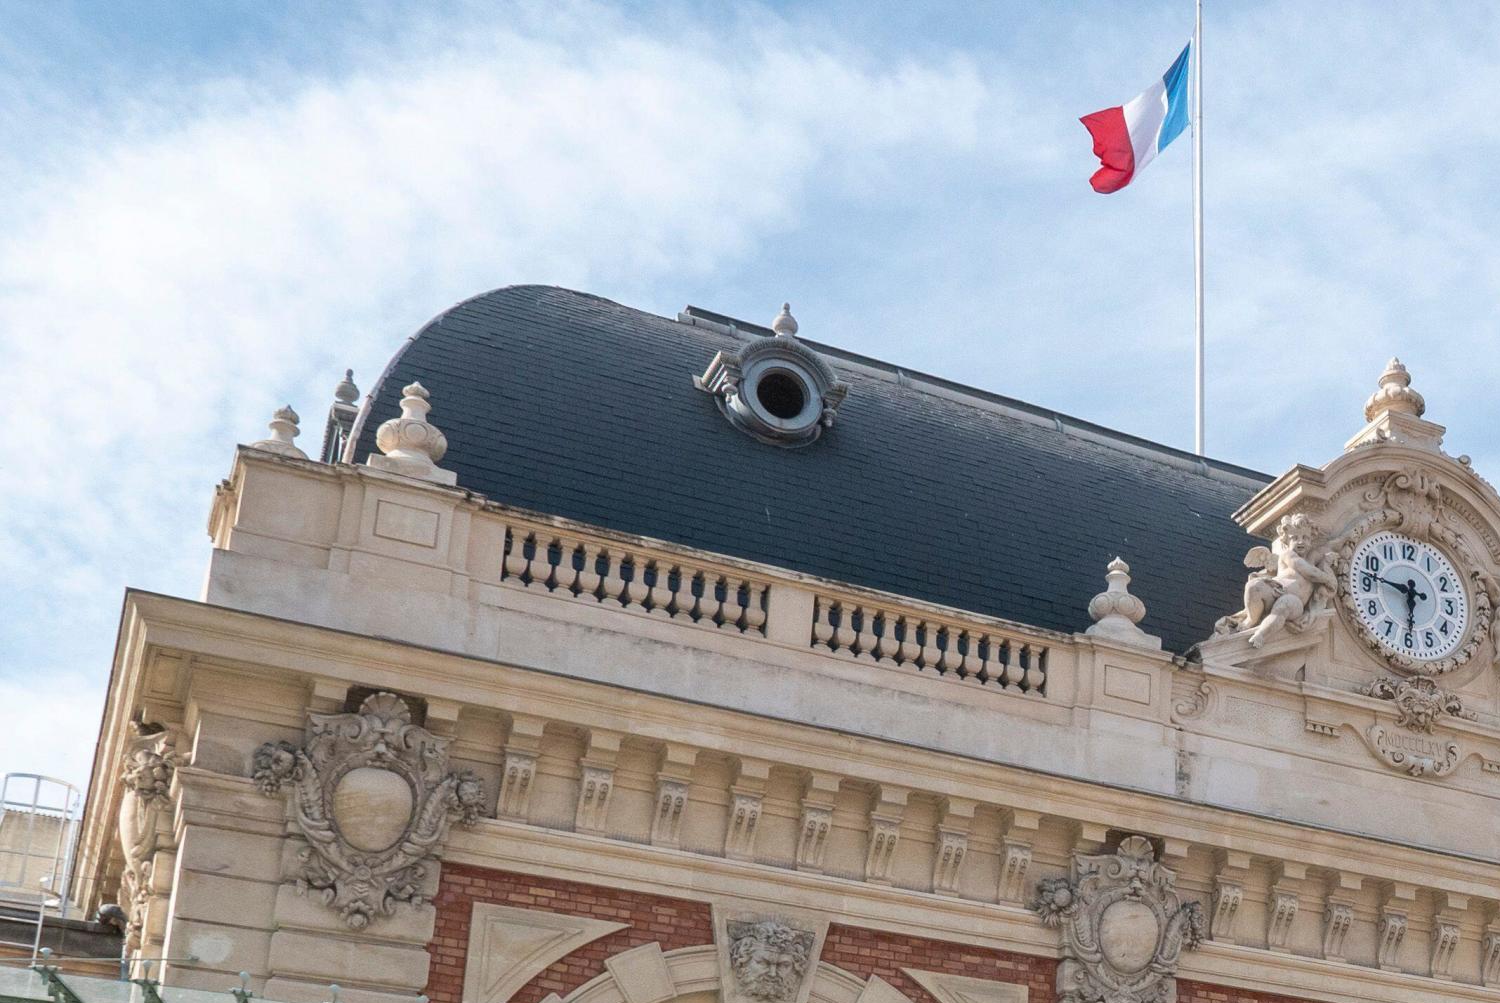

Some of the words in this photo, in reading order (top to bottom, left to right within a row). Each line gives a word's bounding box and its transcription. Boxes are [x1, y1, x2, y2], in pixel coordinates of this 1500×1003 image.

[1383, 545, 1393, 560] 11
[1402, 544, 1415, 561] 12
[1366, 555, 1379, 572] 10
[1426, 557, 1431, 572] 1
[1362, 577, 1372, 592] 9
[1439, 576, 1448, 592] 2
[1368, 600, 1377, 616] 8
[1445, 599, 1454, 616] 3
[1384, 620, 1393, 636] 7
[1440, 620, 1448, 635] 4
[1404, 632, 1413, 648] 6
[1425, 632, 1434, 648] 5
